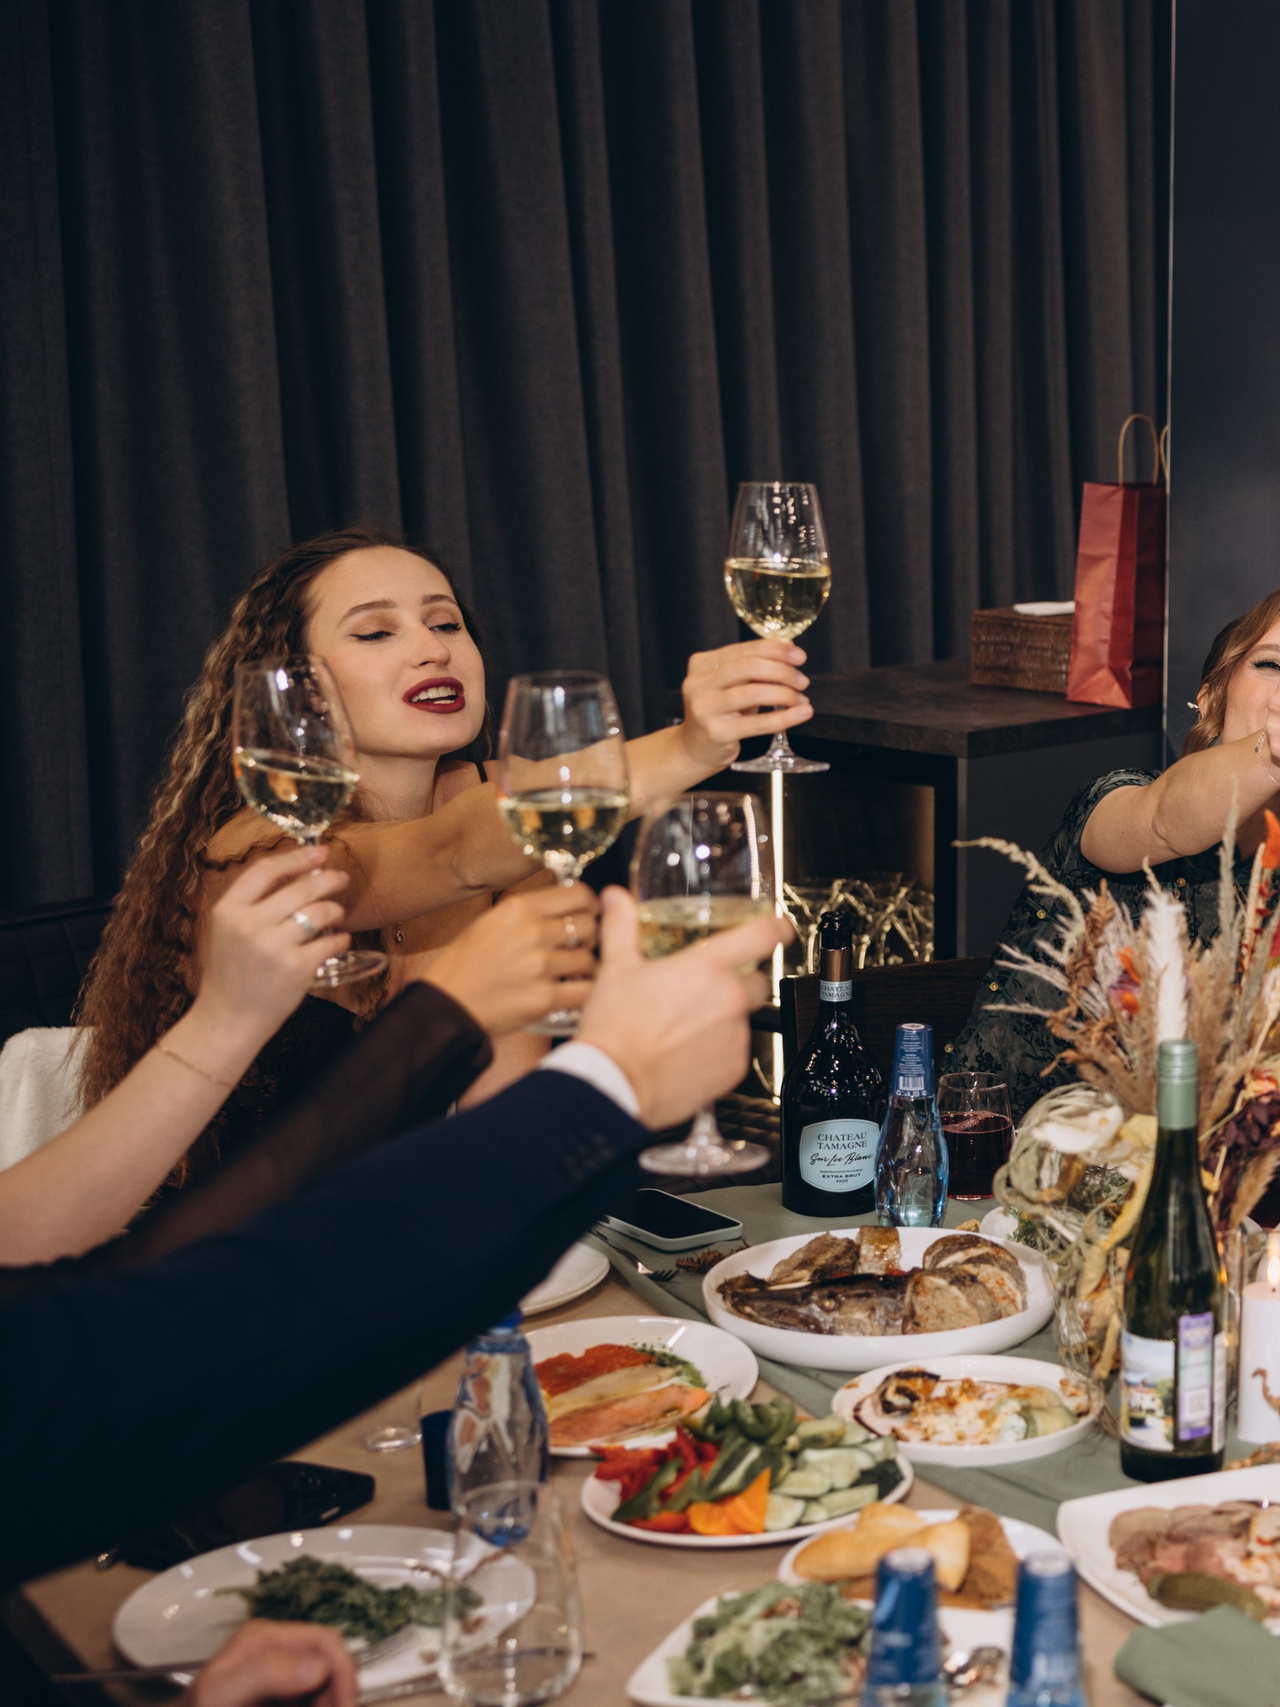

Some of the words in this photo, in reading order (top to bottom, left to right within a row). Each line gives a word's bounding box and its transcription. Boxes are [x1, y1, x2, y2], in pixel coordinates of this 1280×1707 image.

[817, 1132, 868, 1141] CHATEAU
[817, 1140, 868, 1150] TAMAGNE
[810, 1152, 828, 1165] Sur
